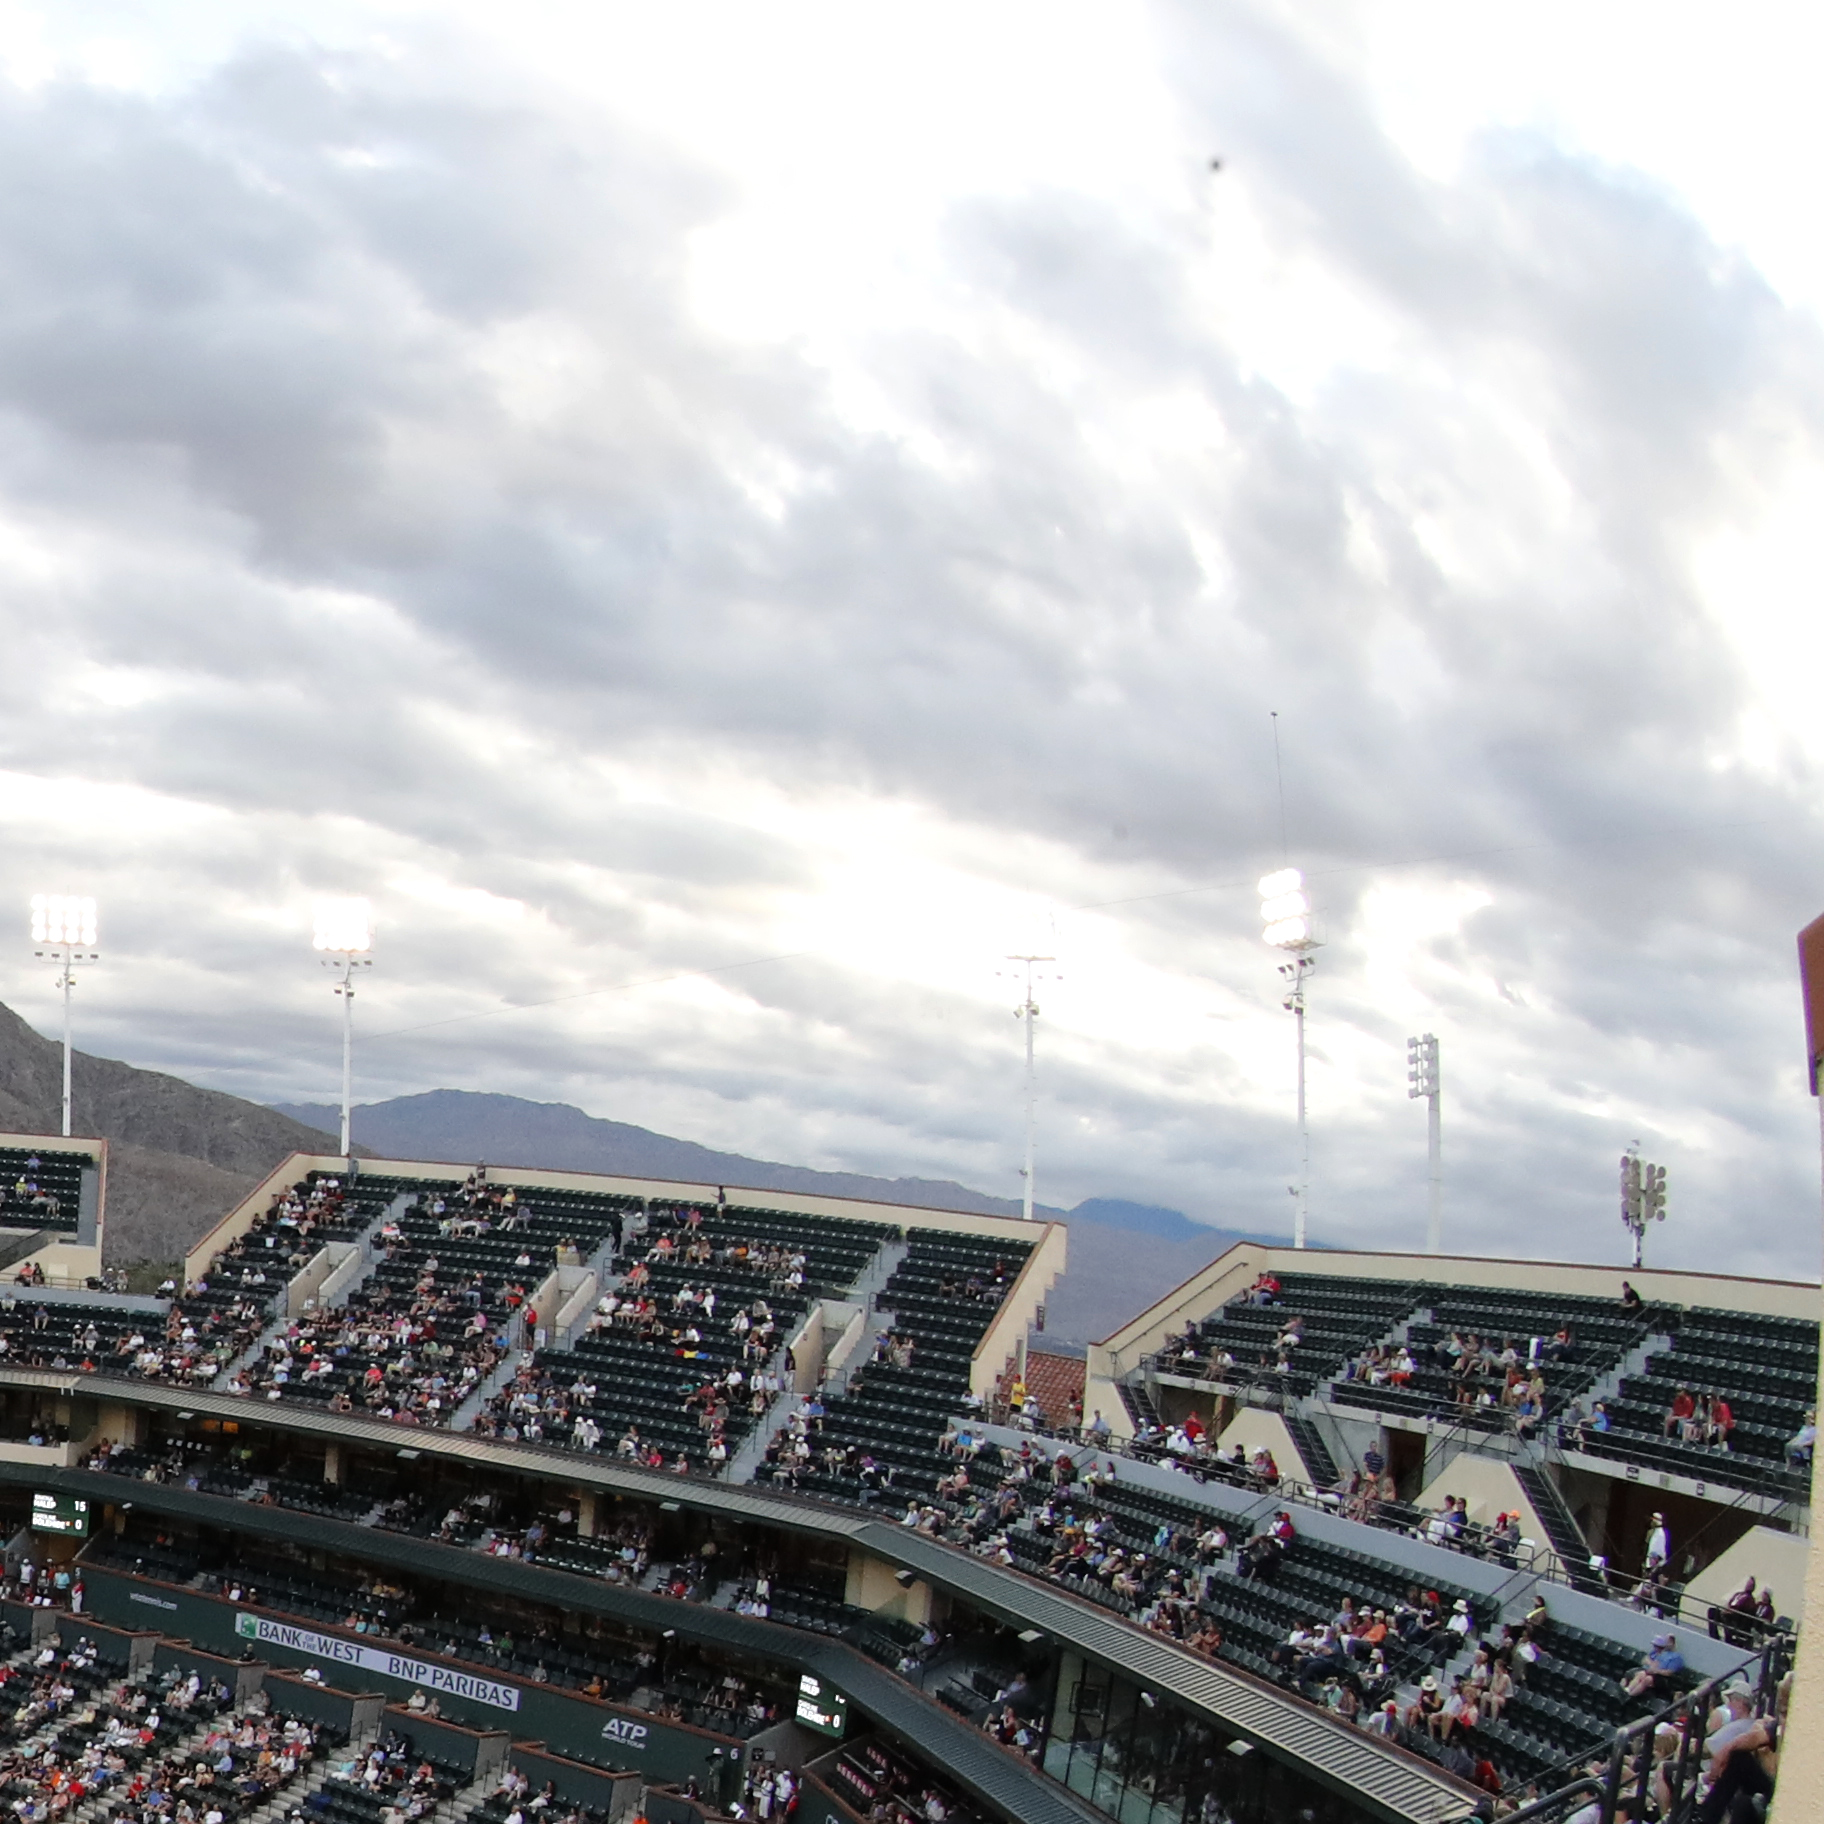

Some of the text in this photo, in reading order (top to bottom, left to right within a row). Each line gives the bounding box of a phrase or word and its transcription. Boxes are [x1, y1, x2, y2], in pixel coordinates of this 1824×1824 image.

[74, 1500, 86, 1512] 15
[75, 1519, 83, 1530] 0
[259, 1620, 513, 1707] BANK OF THE WEST BNP PARIBAS
[603, 1718, 648, 1740] ATP
[832, 1714, 841, 1729] 0
[602, 1732, 646, 1750] WORLD TOUR
[730, 1748, 739, 1760] 6
